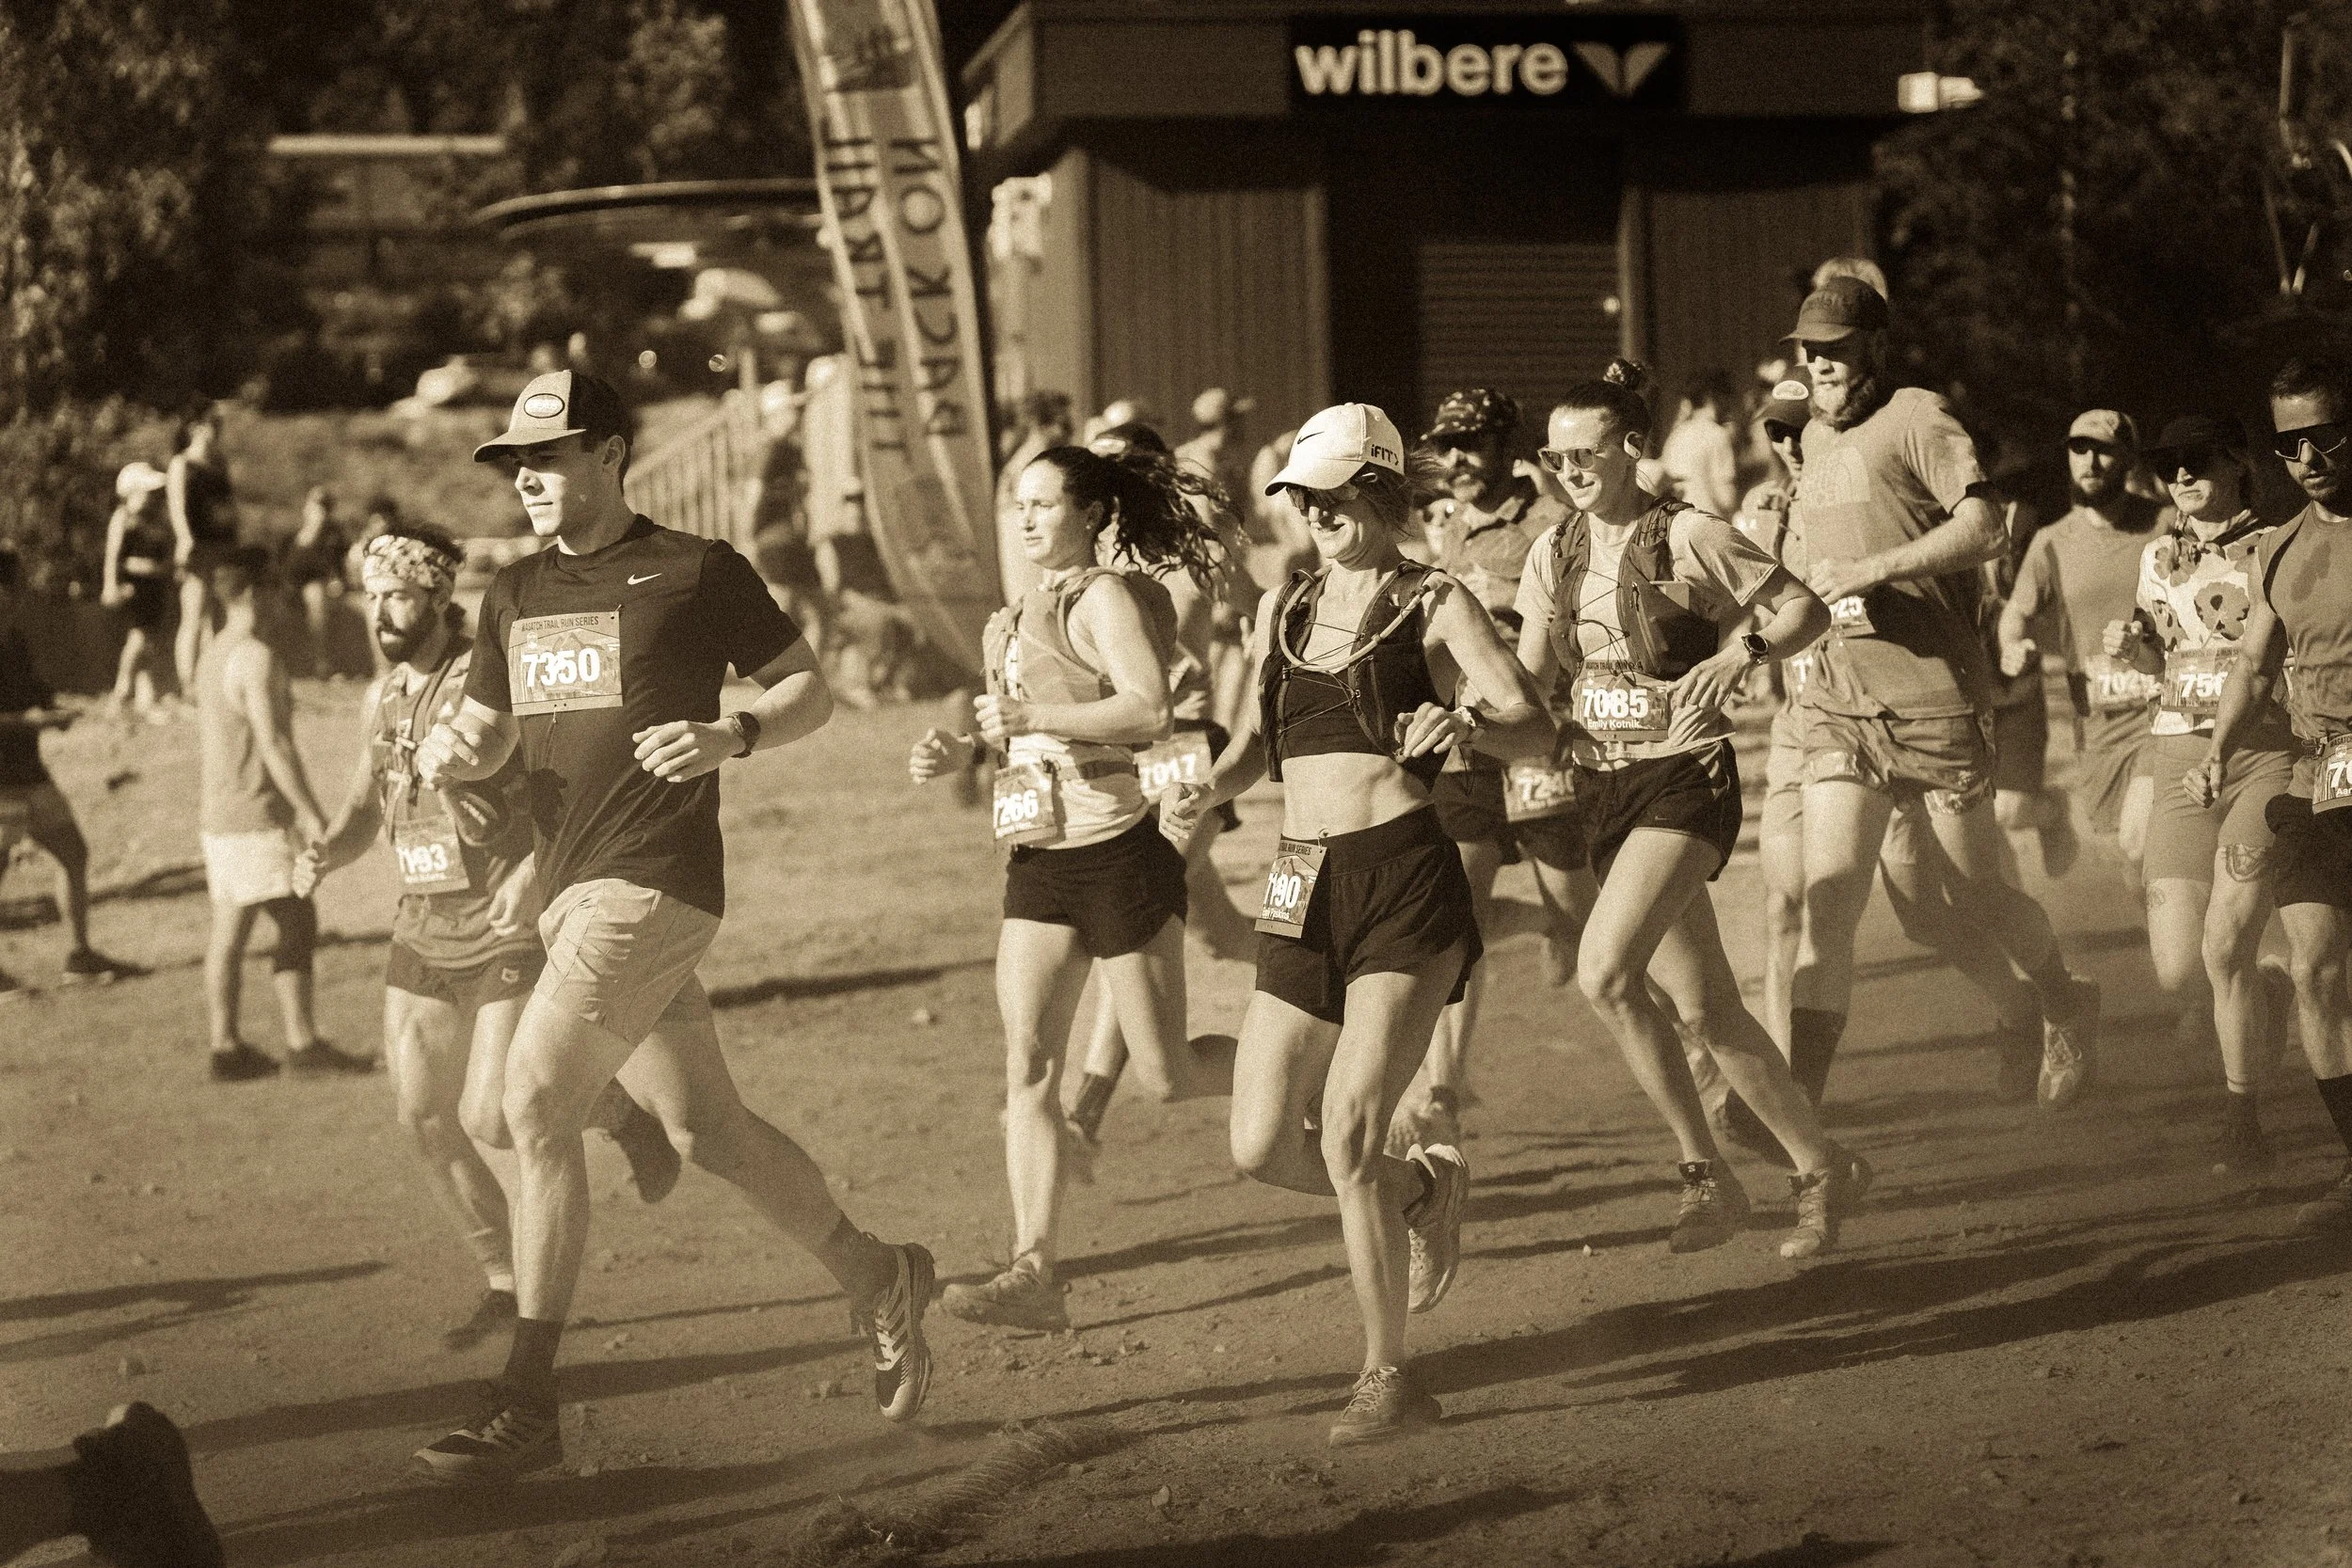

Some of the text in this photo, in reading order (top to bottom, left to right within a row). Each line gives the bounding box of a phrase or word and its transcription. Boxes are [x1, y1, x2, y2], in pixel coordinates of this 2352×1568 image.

[1295, 29, 1568, 95] wilbere
[1371, 444, 1393, 463] iFIT
[544, 620, 560, 629] TRAIL
[561, 618, 574, 627] RUN
[575, 616, 599, 626] SERIES
[521, 647, 600, 688] 7350
[1582, 689, 1649, 719] 7085
[1587, 719, 1640, 731] Emily Kotnik
[1138, 752, 1197, 790] 7017
[1295, 845, 1312, 856] SERIES
